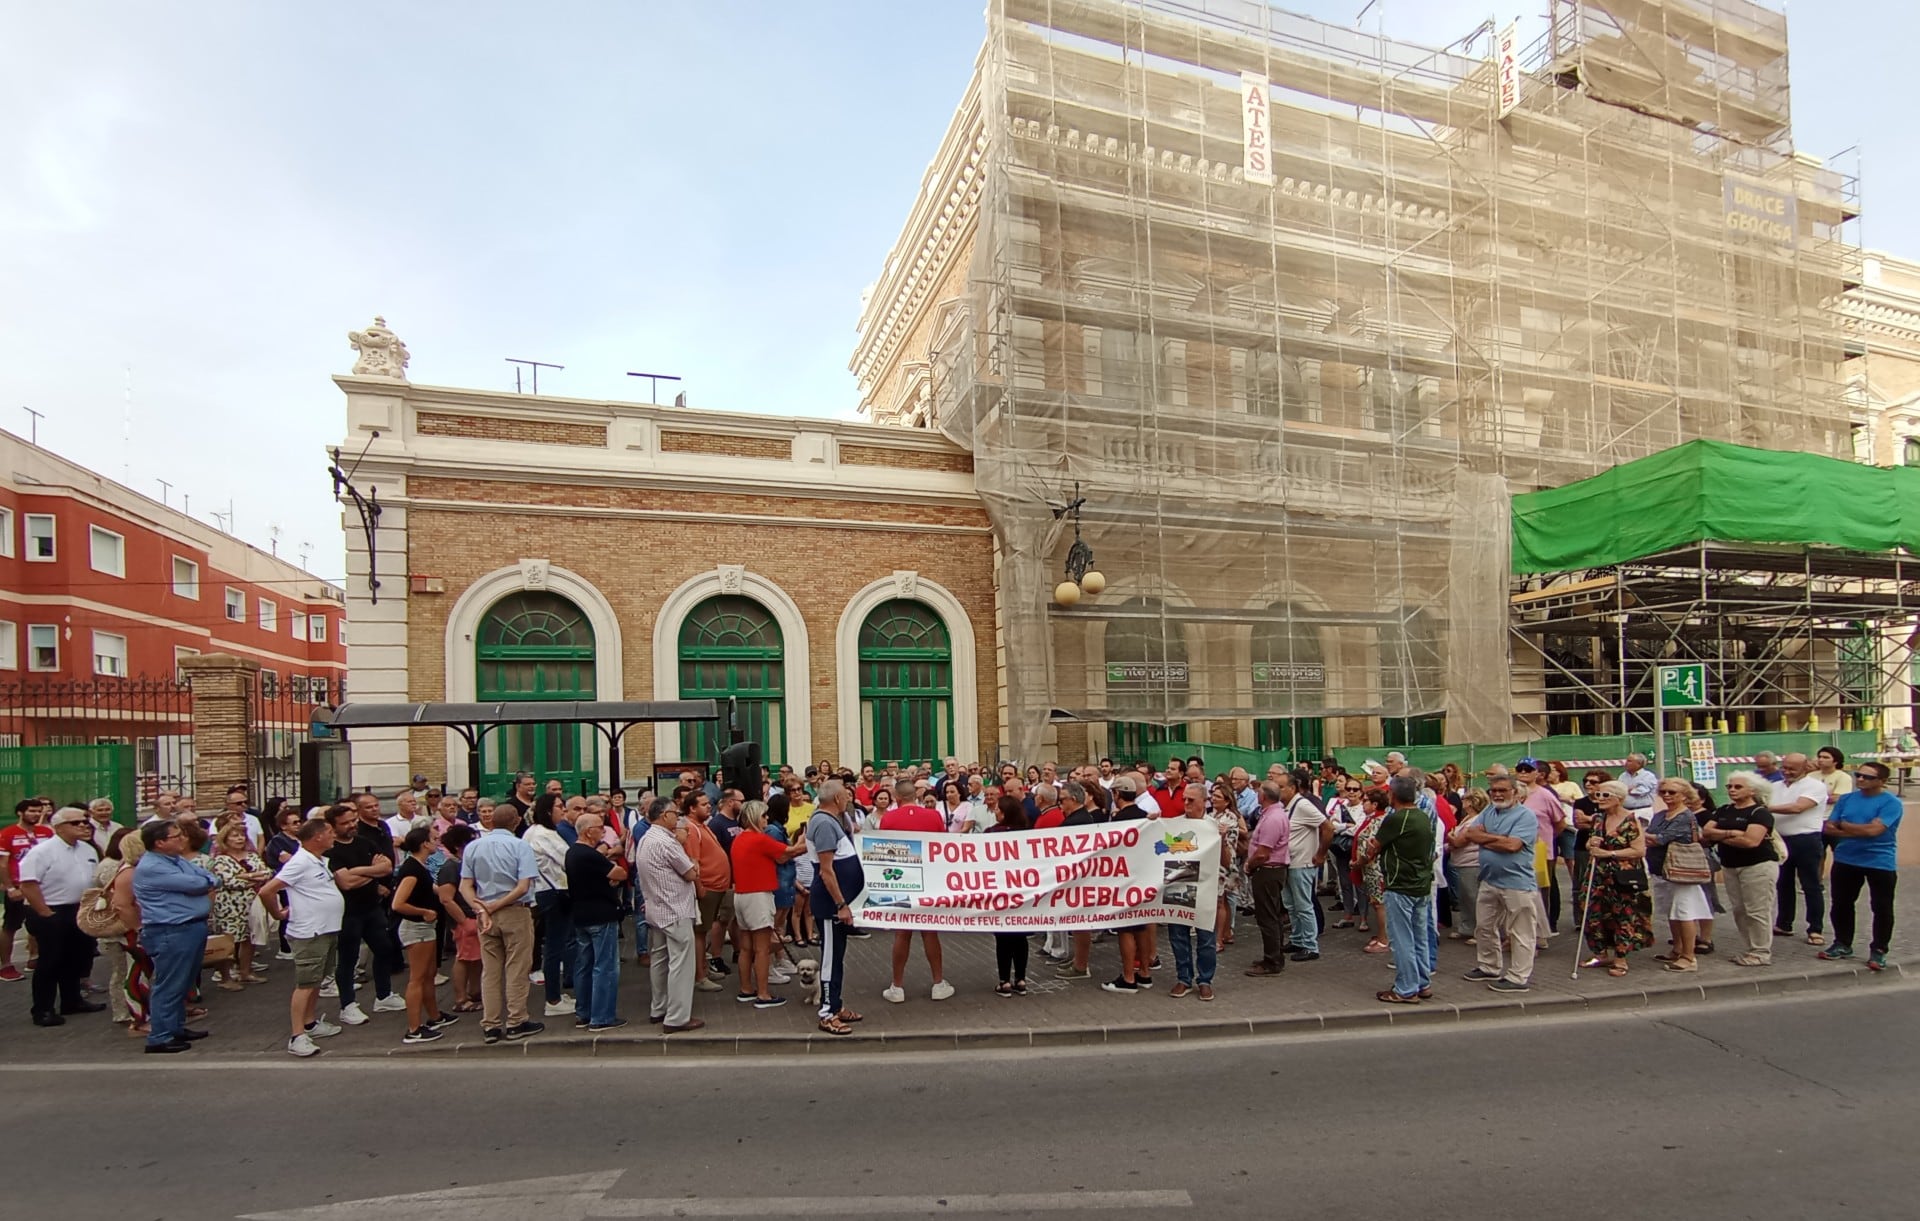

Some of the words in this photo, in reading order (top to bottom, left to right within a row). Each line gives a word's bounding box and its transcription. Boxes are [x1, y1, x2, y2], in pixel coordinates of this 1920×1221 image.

[1246, 86, 1266, 171] ATES
[1111, 666, 1185, 679] enteprise
[1664, 671, 1677, 685] P
[928, 841, 978, 863] POR
[984, 840, 1019, 862] UN
[1026, 827, 1139, 859] TRAZADO
[946, 871, 998, 891] QUE
[1005, 868, 1040, 889] NO
[1055, 856, 1129, 884] DIVIDA
[1032, 891, 1048, 907] Y
[1050, 886, 1158, 908] PUEBLOS
[863, 911, 882, 921] POR
[885, 912, 897, 922] LA
[900, 913, 961, 925] INTEGRACIÓN
[964, 916, 976, 925] DE
[978, 915, 1003, 927] FEVE,
[1005, 913, 1056, 927] CERCANÍAS,
[1119, 909, 1166, 920] DISTANCIA
[1169, 909, 1175, 917] Y
[1177, 909, 1195, 921] AVE
